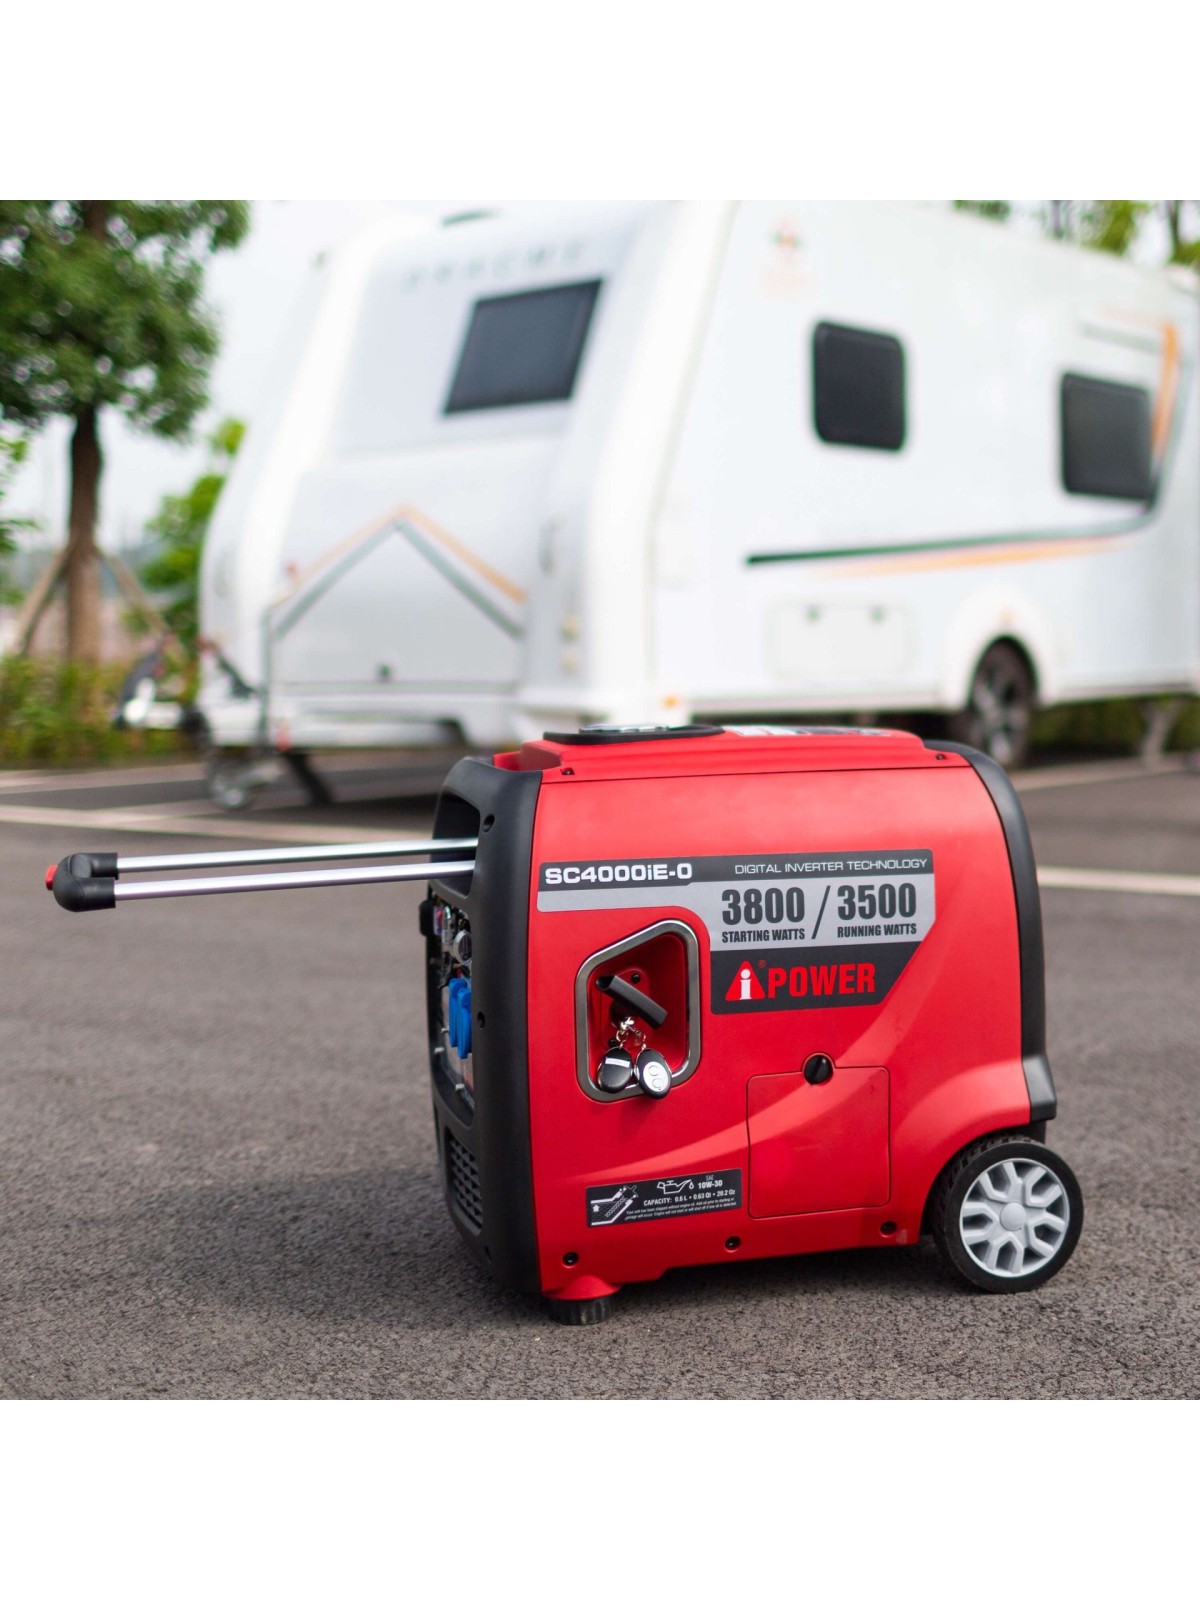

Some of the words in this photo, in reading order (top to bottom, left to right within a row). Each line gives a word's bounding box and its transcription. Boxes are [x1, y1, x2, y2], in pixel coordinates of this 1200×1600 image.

[734, 864, 782, 874] DIGITAL
[785, 861, 844, 873] INVERTER
[846, 858, 928, 870] TECHNOLOGY
[721, 887, 805, 925] 3800
[837, 883, 917, 920] 3500
[721, 929, 770, 943] STARTING
[771, 928, 805, 941] WATTS
[837, 924, 881, 938] RUNNING
[883, 923, 917, 936] WATTS
[698, 1180, 723, 1189] 10W-30
[643, 1197, 673, 1206] CAPACITY:
